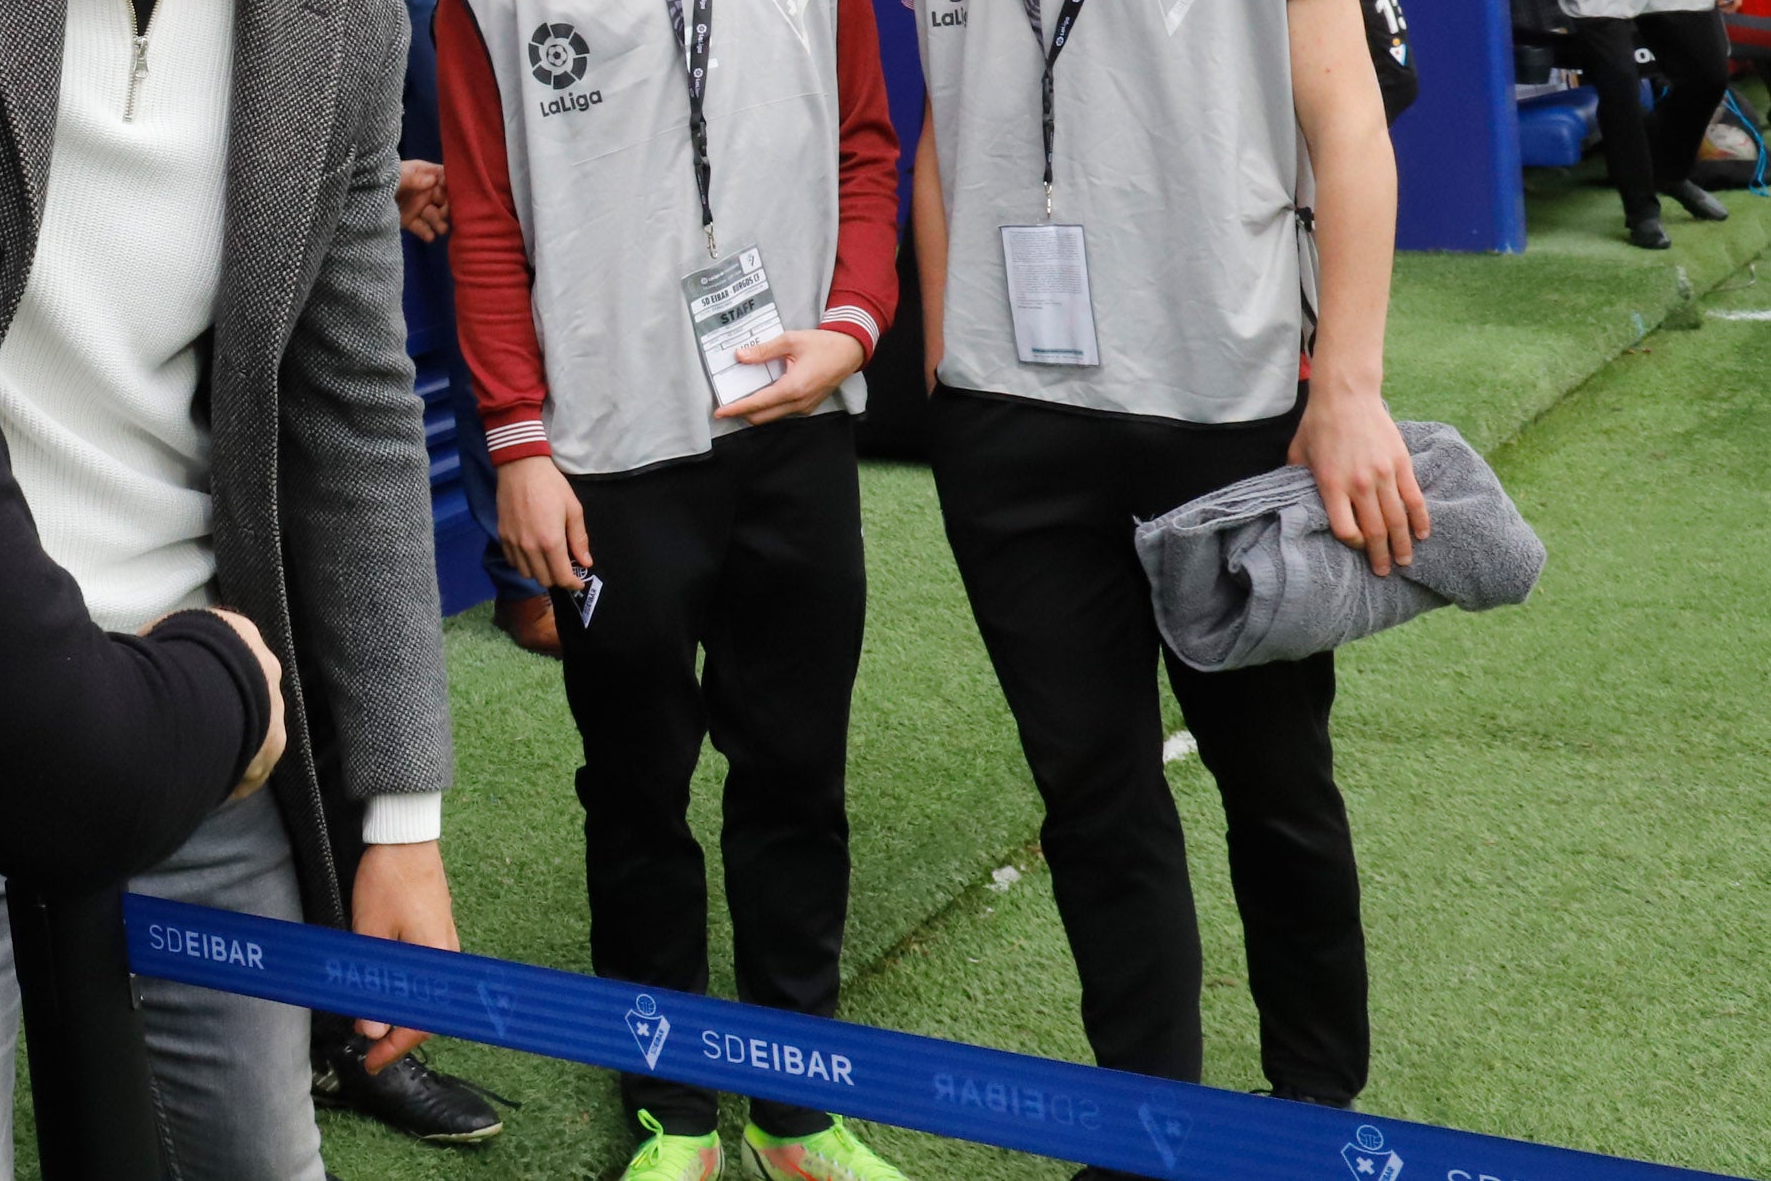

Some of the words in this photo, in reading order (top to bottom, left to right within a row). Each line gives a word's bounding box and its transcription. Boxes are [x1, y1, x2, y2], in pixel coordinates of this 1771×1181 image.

[540, 90, 603, 117] LaLiga
[710, 289, 730, 304] EIBAR
[732, 276, 754, 294] BURGOS
[720, 299, 755, 324] STAFF
[148, 924, 265, 970] SDEIBAR
[701, 1029, 855, 1086] SDEIBAR
